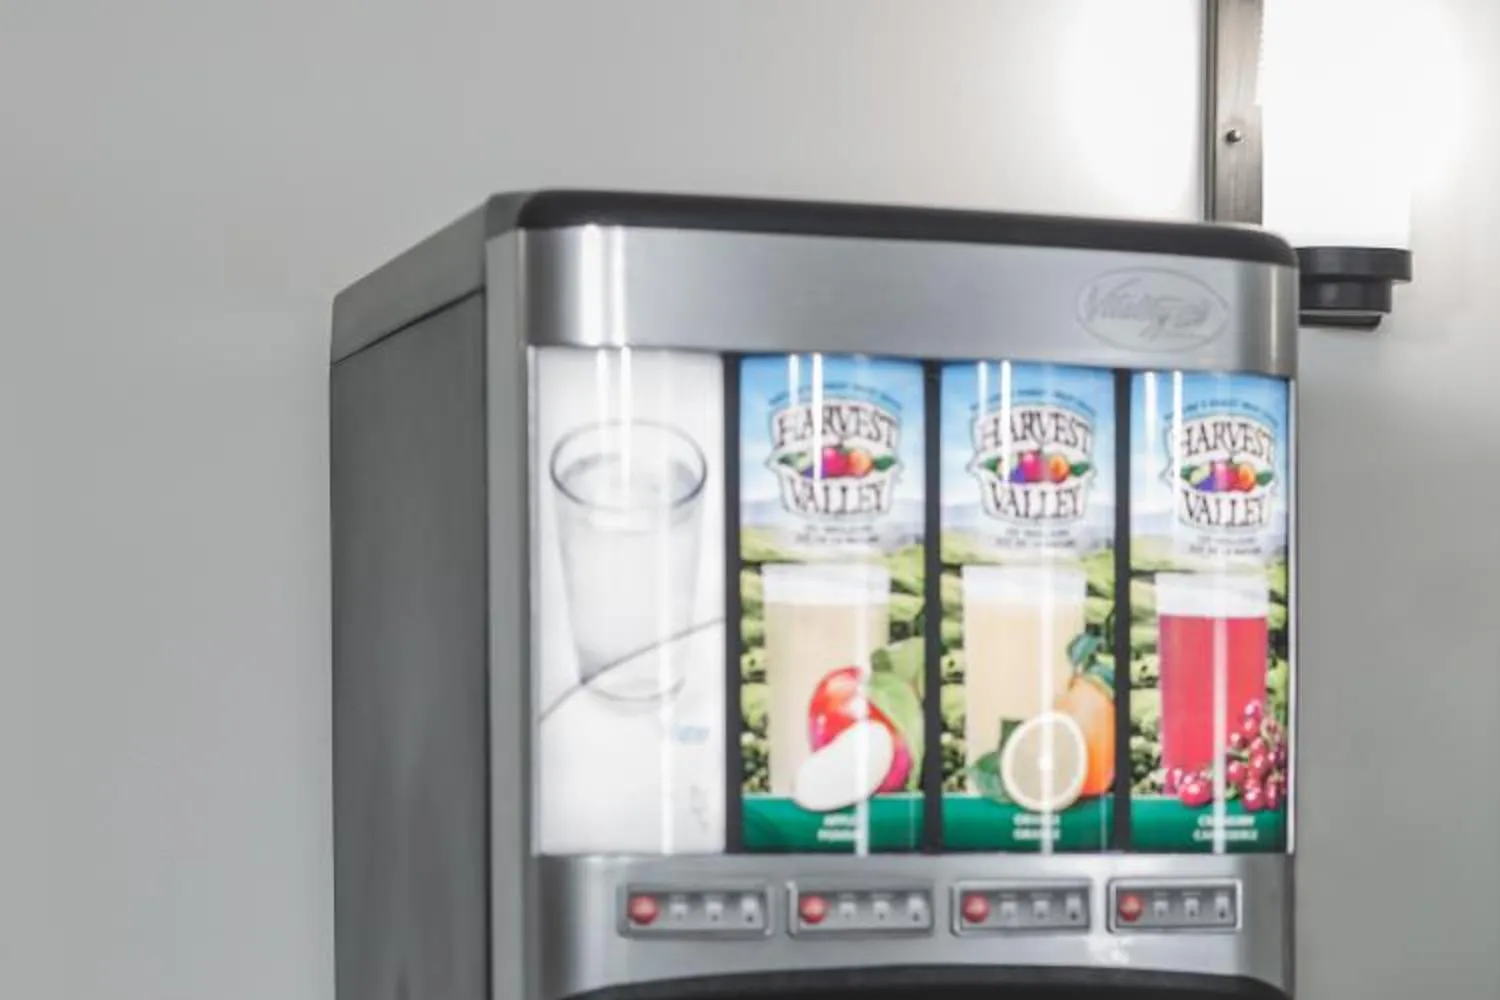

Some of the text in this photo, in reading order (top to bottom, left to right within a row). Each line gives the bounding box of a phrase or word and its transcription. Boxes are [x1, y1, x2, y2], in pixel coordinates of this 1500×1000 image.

[777, 404, 898, 449] HARVEST
[980, 407, 1092, 458] HARVEST
[1181, 420, 1274, 463] HARVEST
[789, 478, 885, 515] VALLEY
[988, 482, 1082, 520] VALLEY
[1183, 490, 1266, 529] VALLEY
